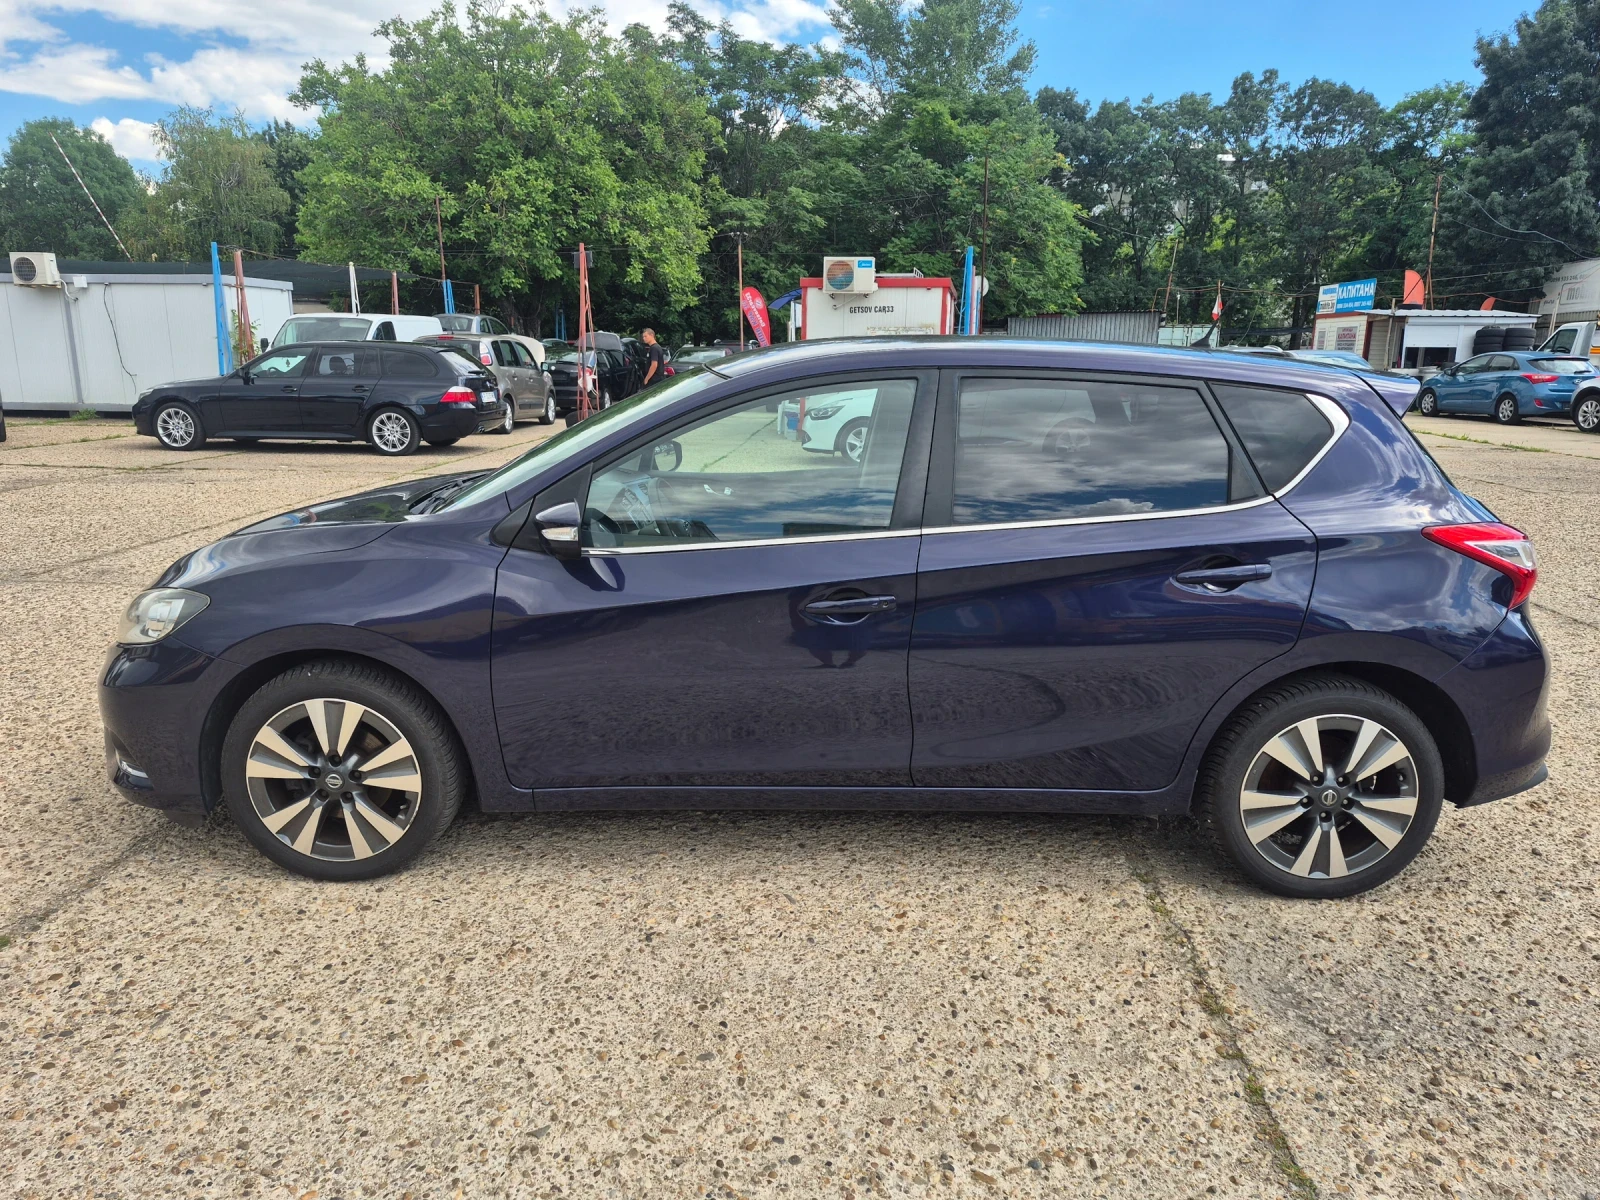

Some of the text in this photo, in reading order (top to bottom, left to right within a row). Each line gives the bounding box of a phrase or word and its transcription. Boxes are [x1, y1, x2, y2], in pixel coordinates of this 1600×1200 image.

[1338, 283, 1374, 299] КАПИТАНА
[849, 305, 894, 314] GETSOV CAR33
